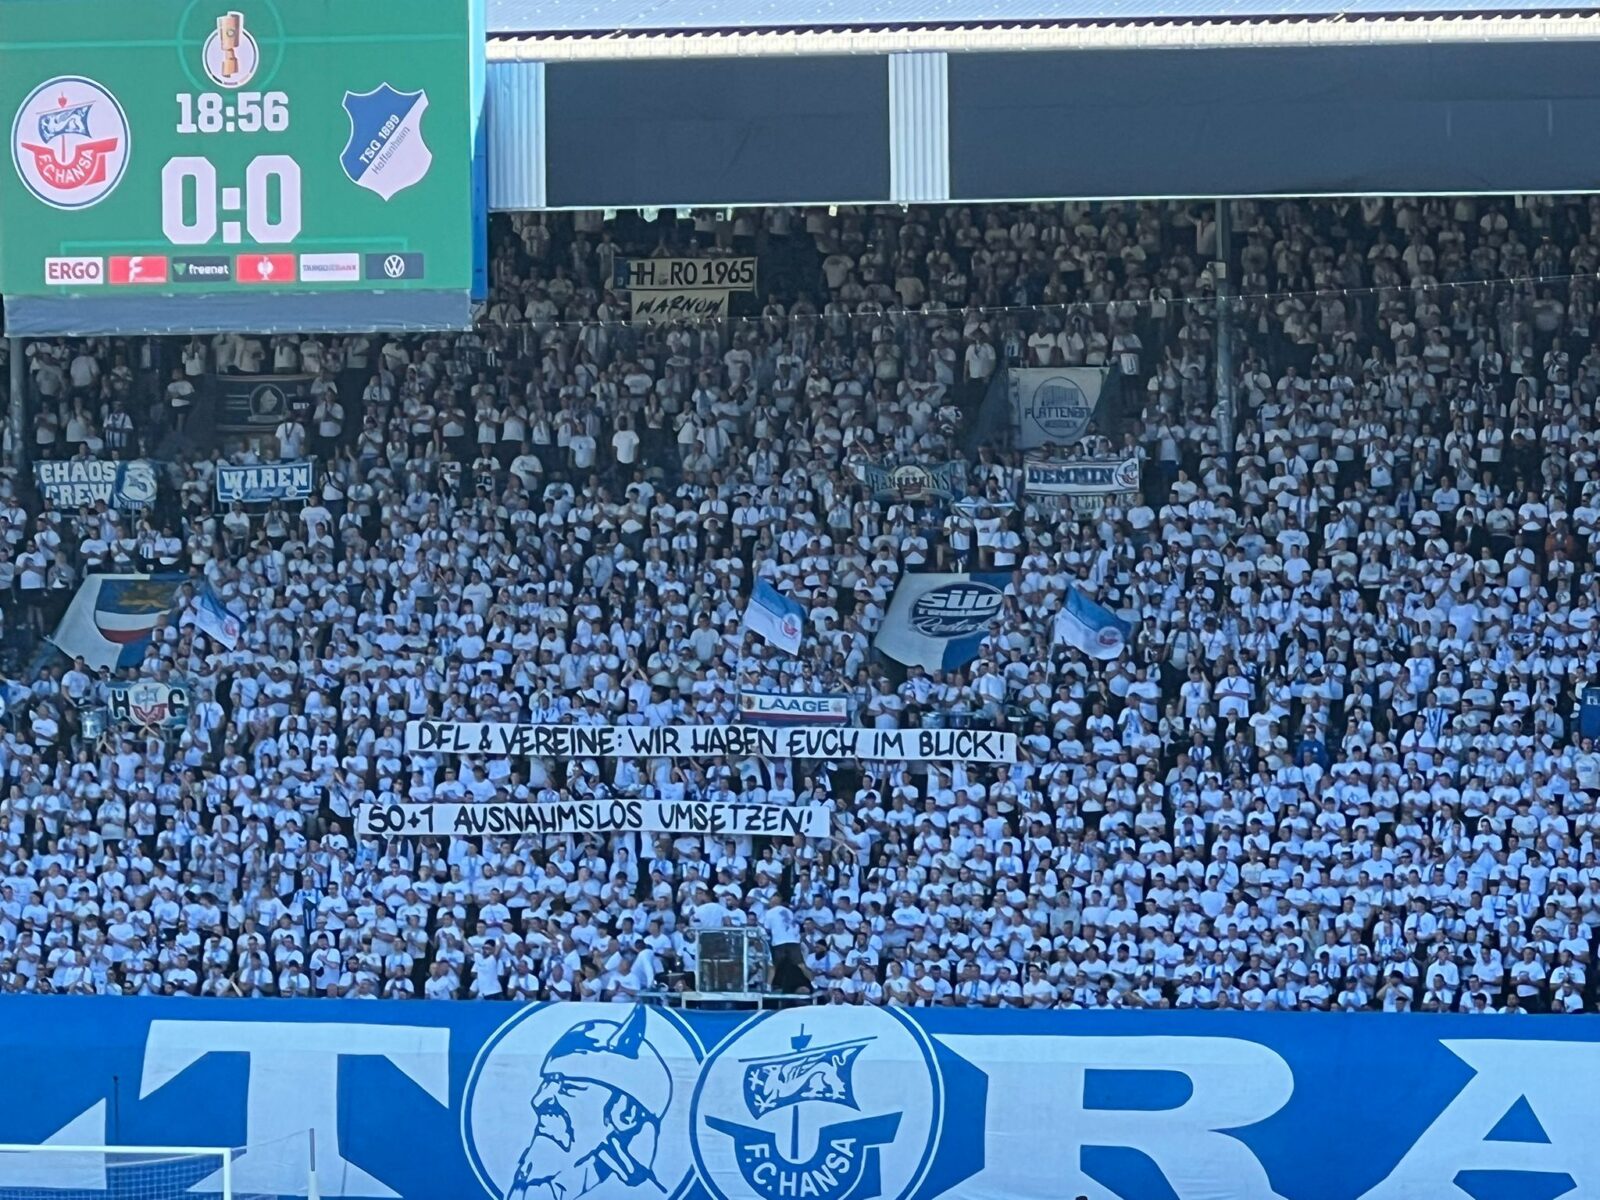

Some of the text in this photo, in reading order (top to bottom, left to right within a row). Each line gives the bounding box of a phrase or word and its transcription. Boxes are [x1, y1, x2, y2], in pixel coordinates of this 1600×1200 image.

[175, 91, 289, 133] 18:56
[359, 139, 381, 165] TSG
[161, 154, 301, 244] 0:0
[48, 262, 100, 280] ERGO
[188, 263, 230, 276] freenet
[671, 261, 698, 286] RO
[702, 260, 755, 285] 1965
[635, 295, 725, 316] WARNOW
[40, 461, 116, 483] CHAOS
[222, 468, 308, 490] WAREN
[1028, 467, 1115, 485] DEMMIN
[45, 484, 113, 509] CREW
[758, 698, 830, 712] LAAGE
[418, 724, 1005, 760] DFL & VEREINE: WIR HABEN EUCH IM BLICK!
[367, 801, 812, 834] 50+1 AUSNAHMSLOS UMSETZEN!
